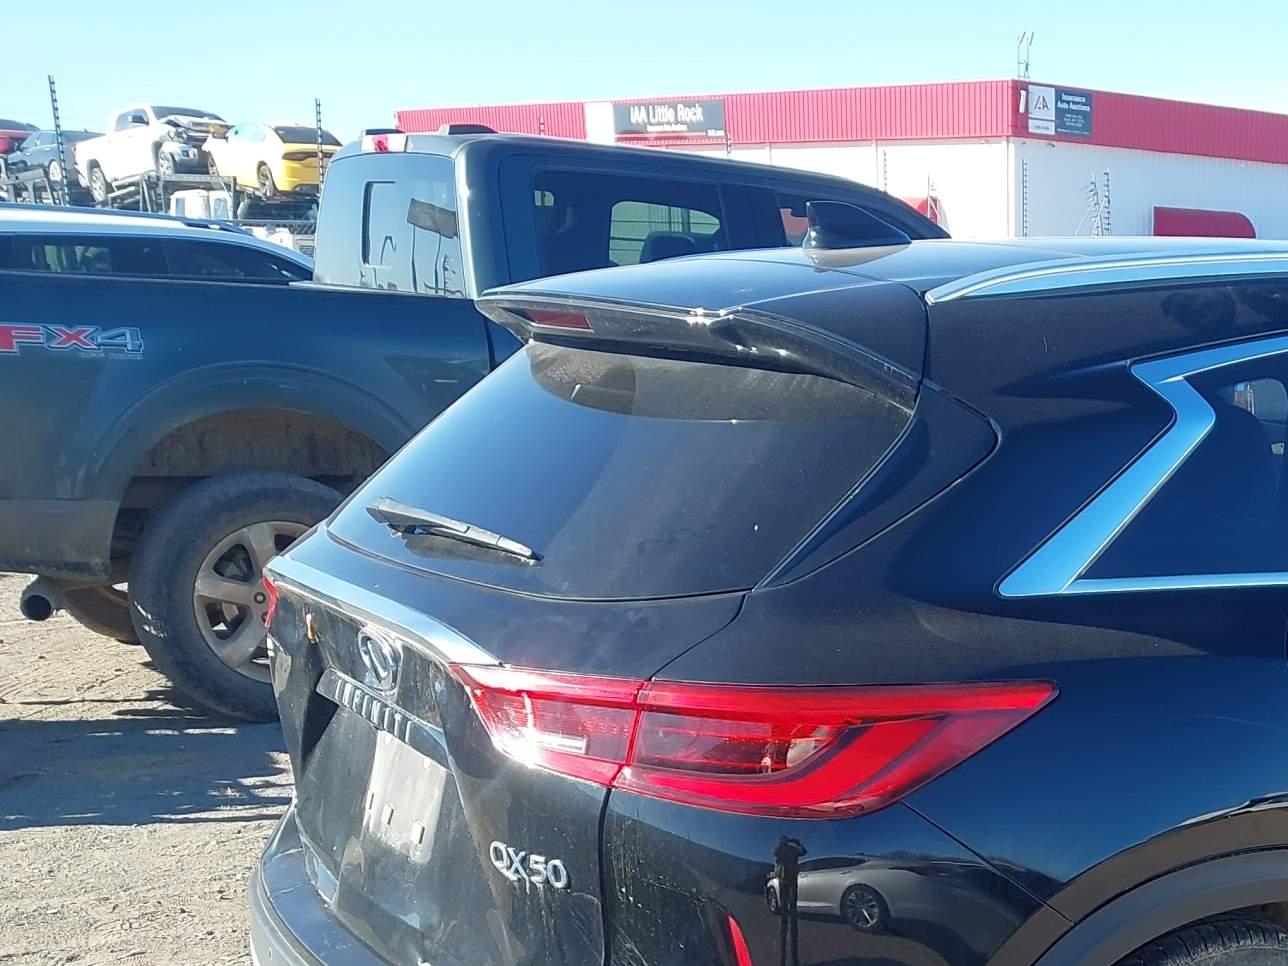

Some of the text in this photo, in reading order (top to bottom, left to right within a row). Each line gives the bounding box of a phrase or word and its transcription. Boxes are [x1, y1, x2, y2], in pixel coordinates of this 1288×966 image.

[630, 103, 703, 123] IAA Little Rock
[1057, 100, 1091, 112] Auto Auctions
[0, 321, 144, 355] FX4
[335, 680, 413, 744] INFINITI
[489, 840, 568, 889] QX50
